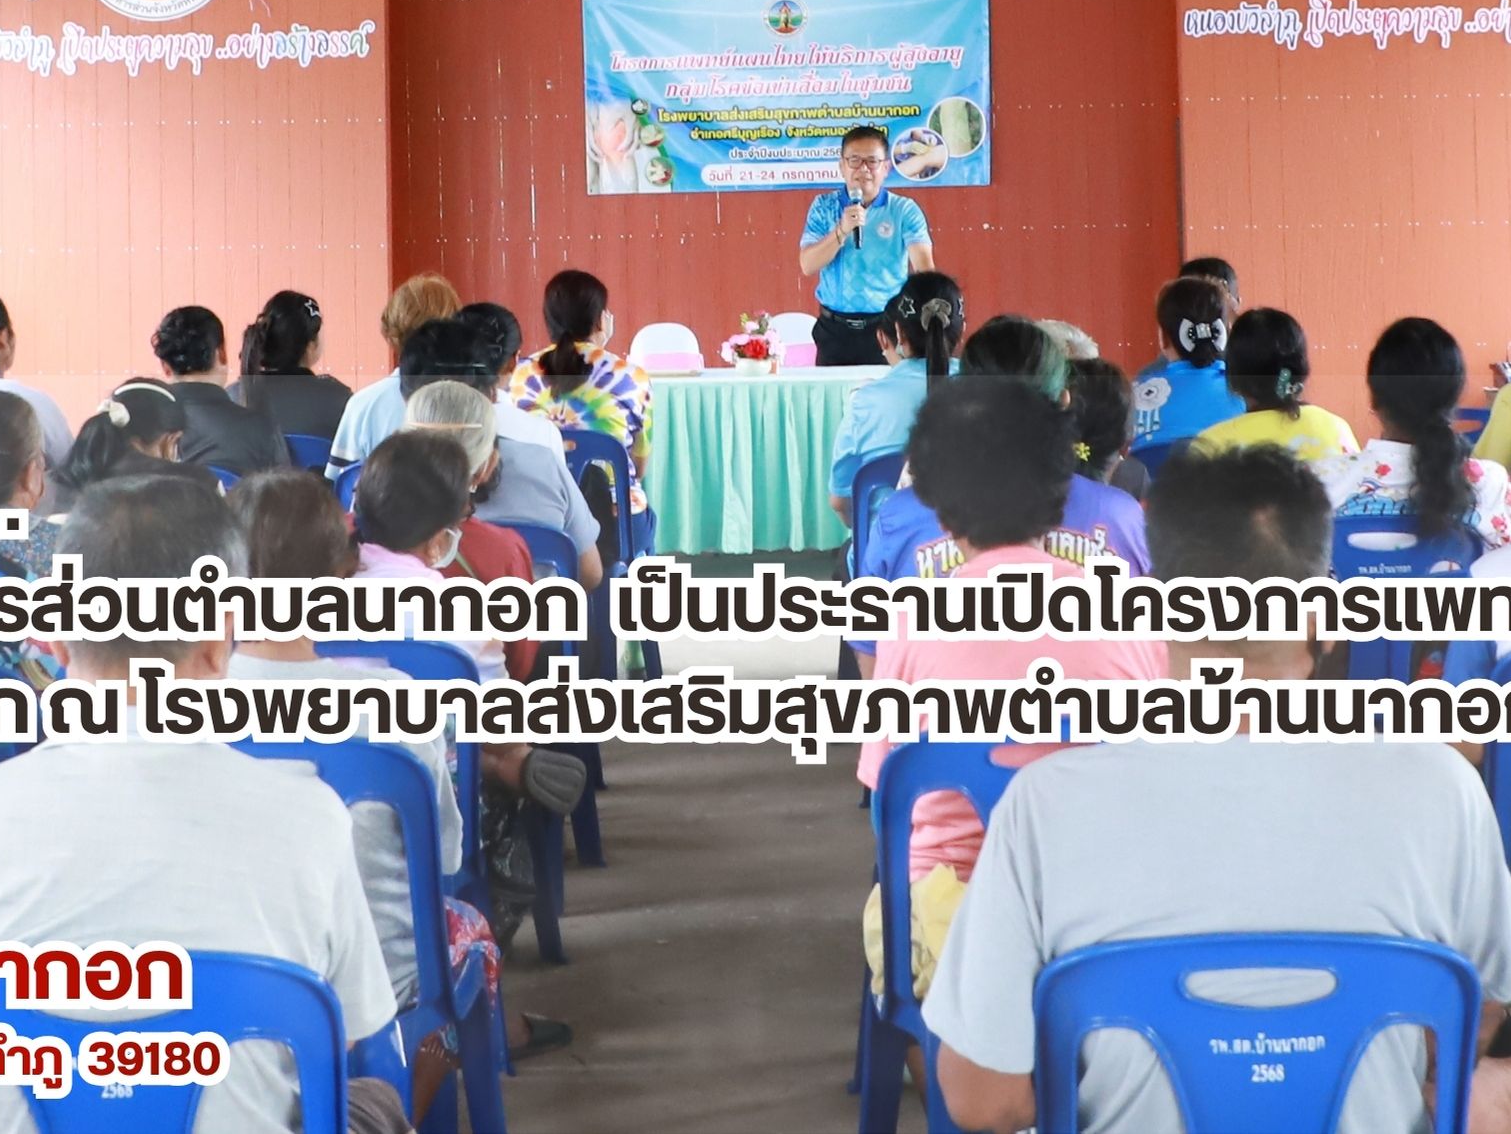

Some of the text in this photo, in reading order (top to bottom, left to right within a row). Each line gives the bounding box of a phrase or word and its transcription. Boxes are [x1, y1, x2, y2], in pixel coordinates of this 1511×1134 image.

[657, 102, 920, 126] โรงพยาบาลส่งเสริมสุขภาพตำบลบ้านนากอก
[822, 146, 843, 158] 256
[707, 164, 734, 183] วันที่
[739, 170, 776, 182] 21-24
[1251, 1063, 1286, 1082] 2568
